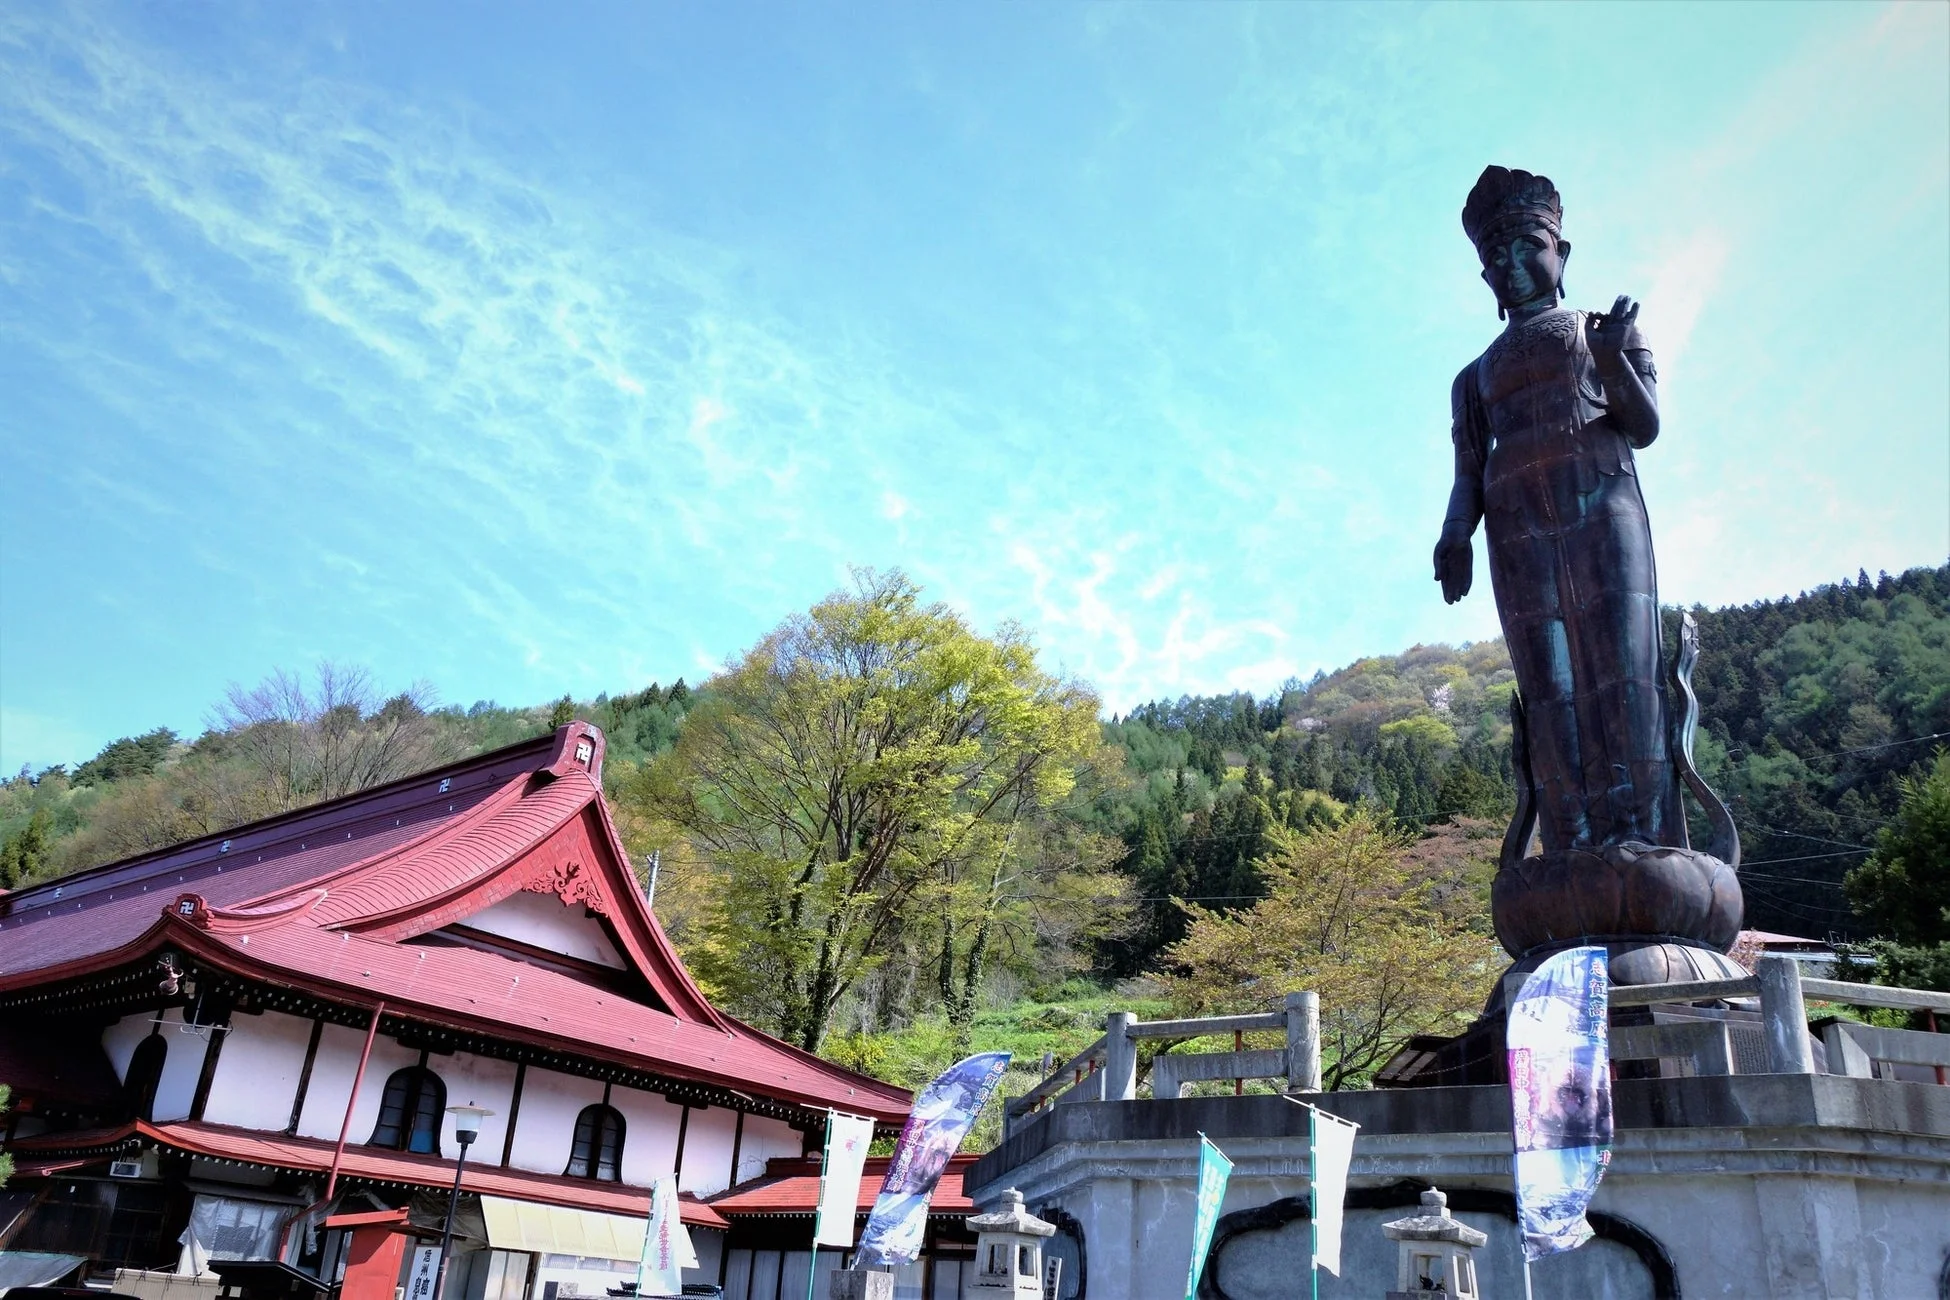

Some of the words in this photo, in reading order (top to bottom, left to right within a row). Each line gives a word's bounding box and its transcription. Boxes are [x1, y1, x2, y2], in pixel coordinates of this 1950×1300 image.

[1588, 958, 1608, 1041] 志賀高原
[968, 1060, 1005, 1119] 志賀高原
[1514, 1050, 1531, 1150] 湯田中温泉
